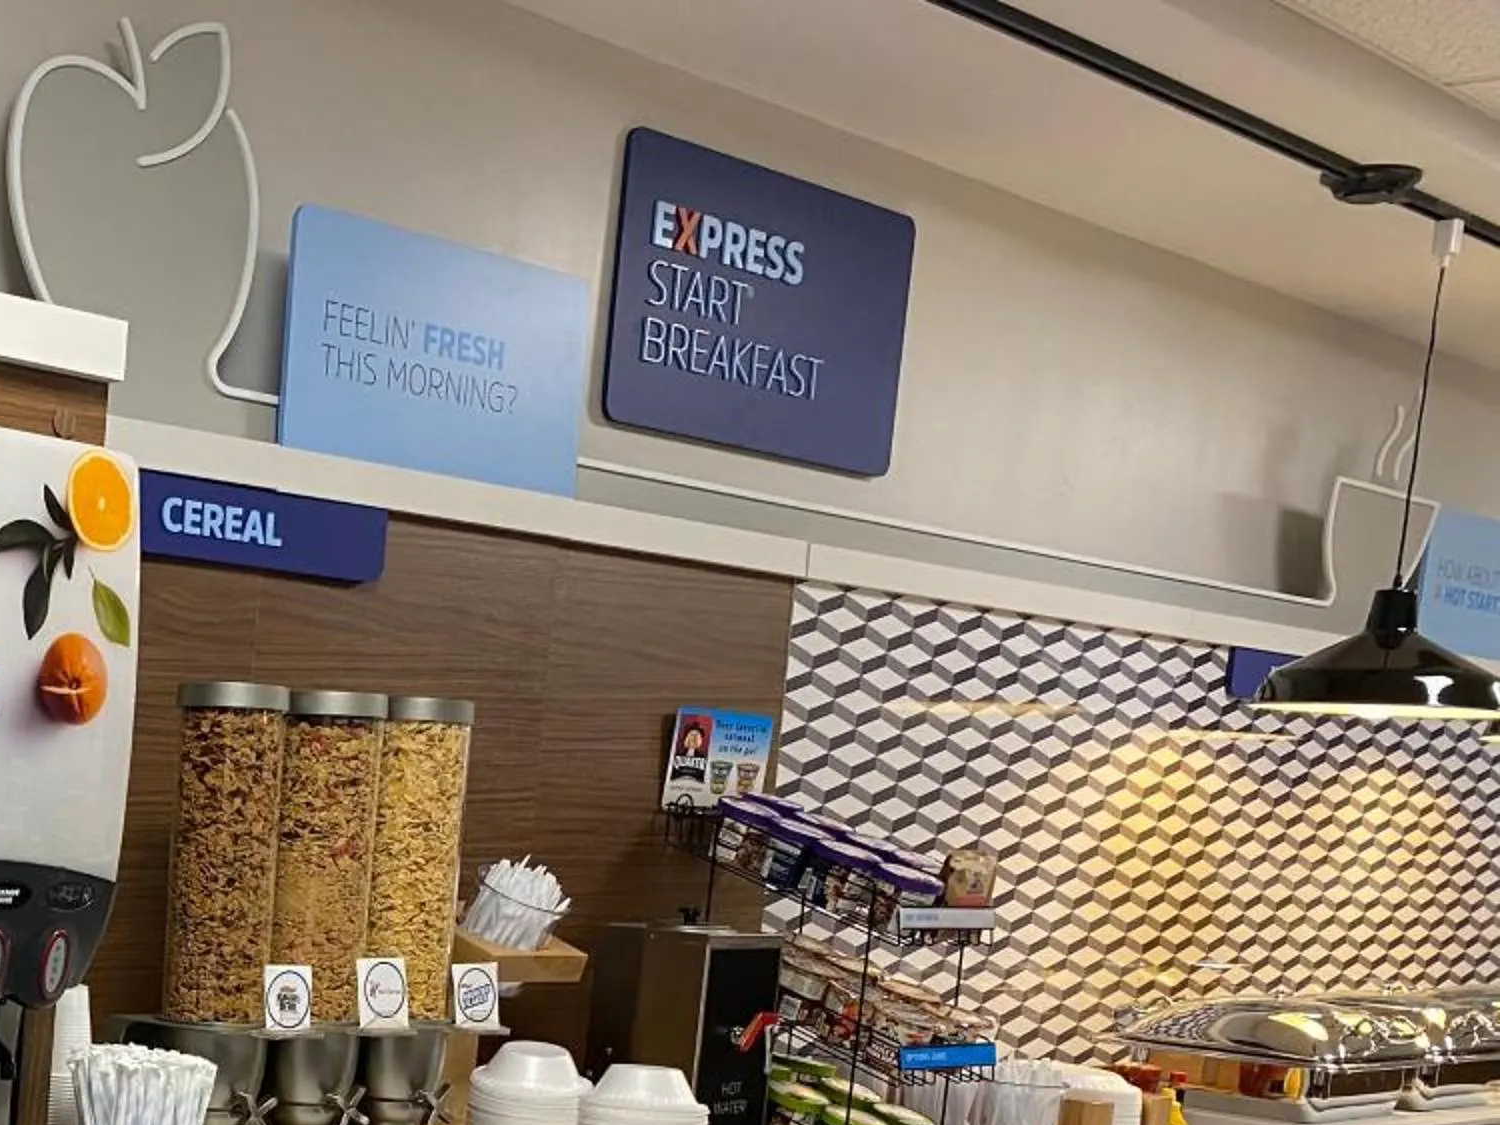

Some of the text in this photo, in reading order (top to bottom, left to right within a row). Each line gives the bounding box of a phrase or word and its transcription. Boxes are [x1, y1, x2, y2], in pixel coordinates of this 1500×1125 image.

[652, 199, 805, 285] EXPRESS
[647, 259, 749, 325] START
[322, 299, 506, 371] FEELIN' FRESH
[641, 316, 825, 401] BREAKFAST
[322, 342, 519, 415] THIS MORNING?
[161, 496, 283, 548] CEREAL
